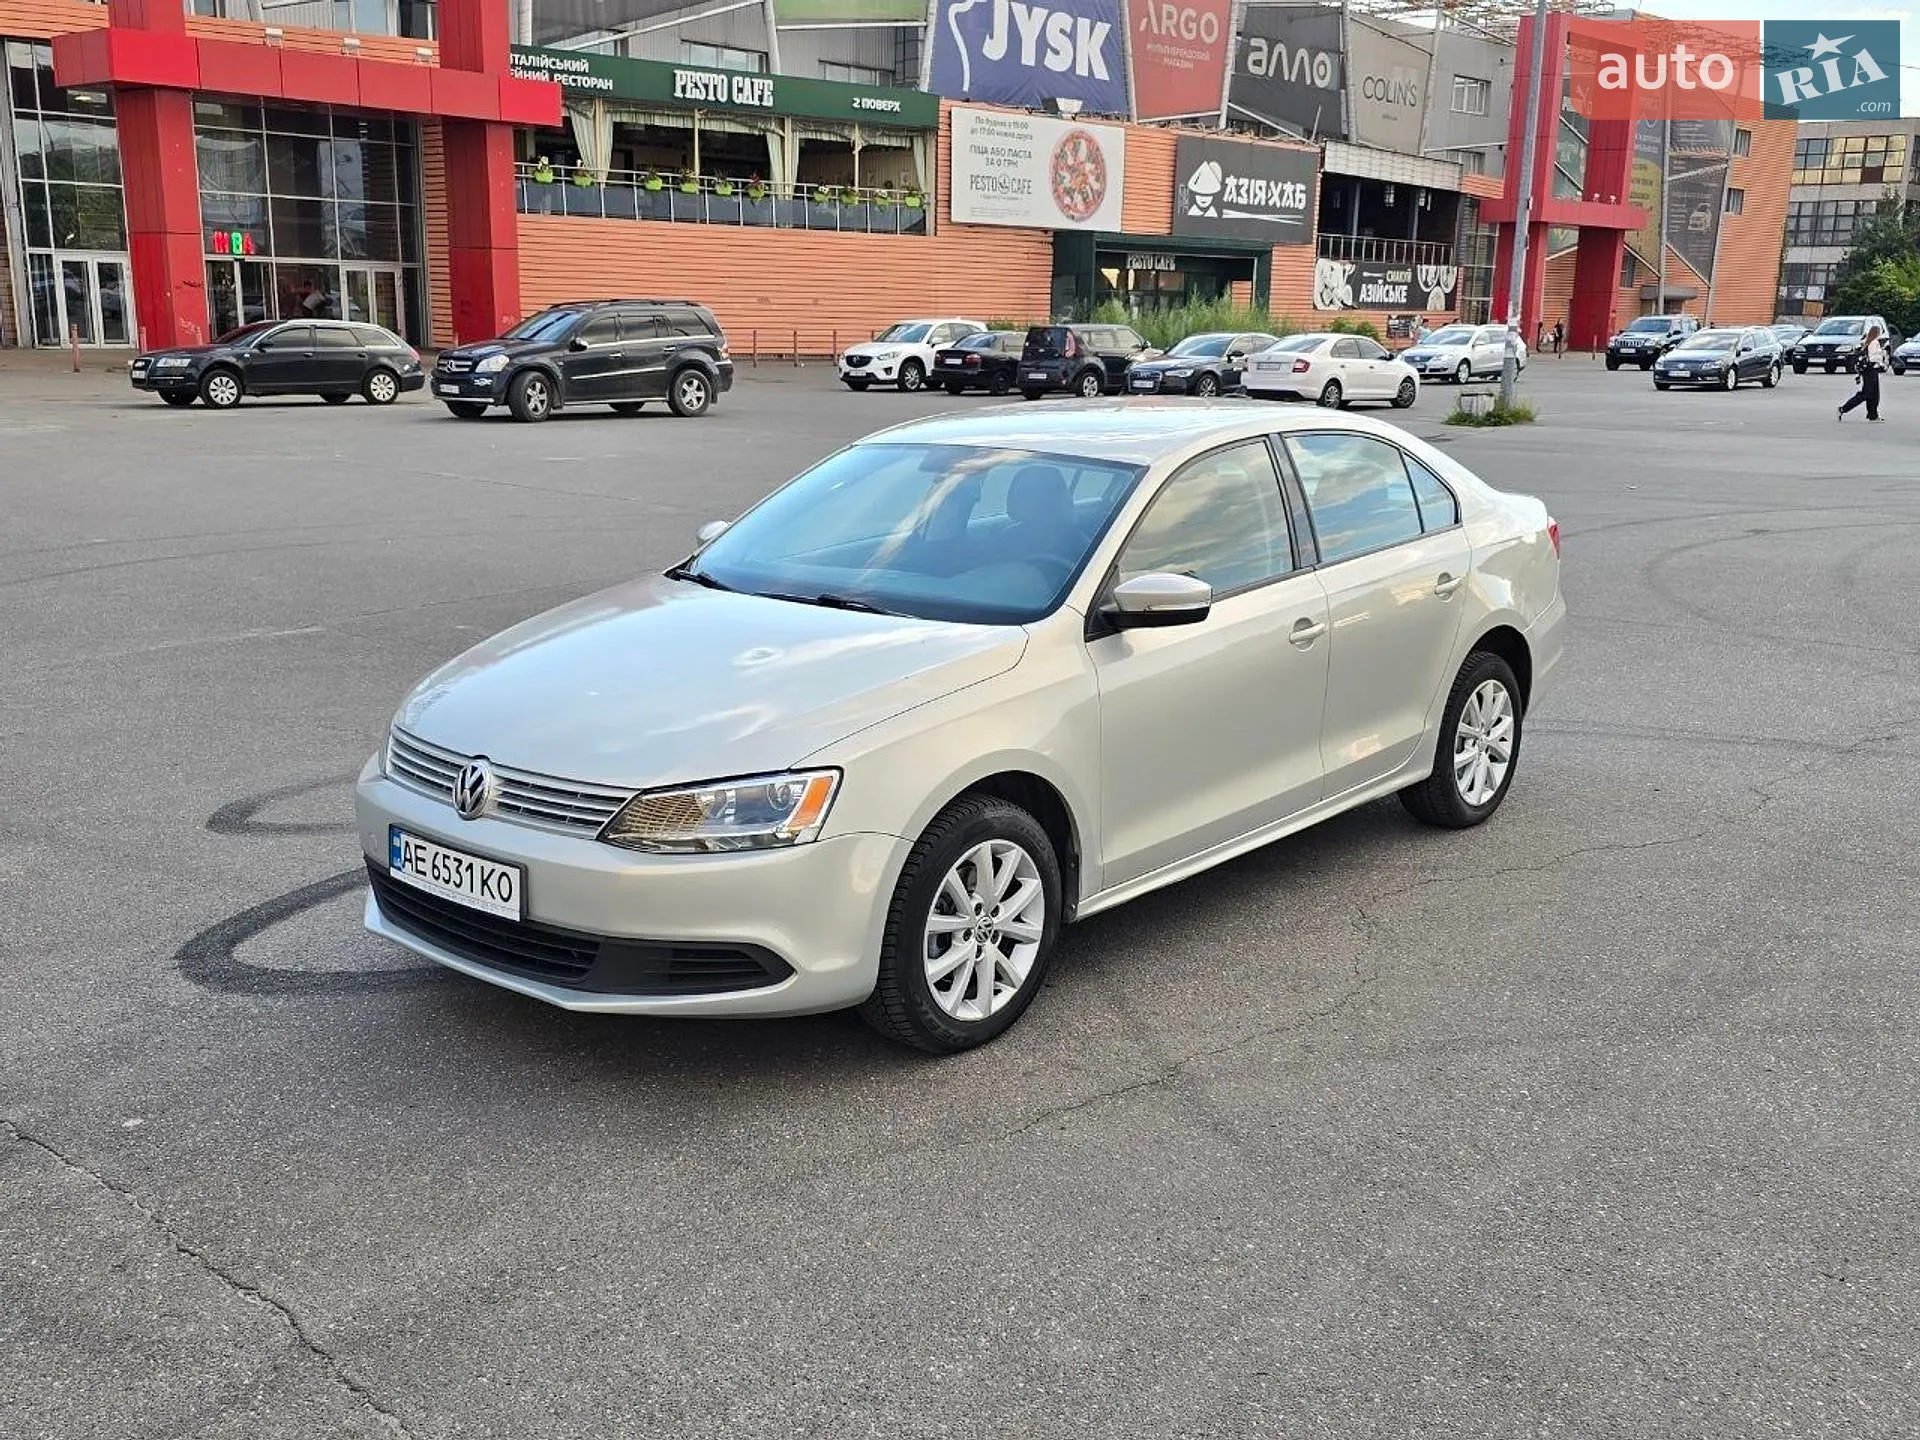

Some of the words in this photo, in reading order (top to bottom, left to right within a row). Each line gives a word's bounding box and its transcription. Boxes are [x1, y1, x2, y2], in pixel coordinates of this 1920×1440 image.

[1140, 0, 1219, 44] ARGO
[982, 0, 1112, 81] JYSK
[553, 73, 613, 90] РЕСТОРАН
[673, 69, 728, 103] PESTO
[732, 75, 774, 107] CAFE
[1362, 76, 1417, 107] COLIN'S
[852, 97, 861, 109] 2
[862, 97, 901, 113] ПОВЕРХ
[985, 157, 994, 167] ЗА
[990, 147, 1006, 157] АБО
[1007, 148, 1032, 159] ПАСТА
[970, 174, 997, 192] PESTO
[1011, 178, 1032, 195] CAFE
[1127, 254, 1153, 269] PESTO
[1359, 279, 1408, 303] АЗІЙСЬКЕ
[401, 840, 427, 877] AE
[432, 851, 474, 893] 6531
[480, 865, 512, 902] KO
